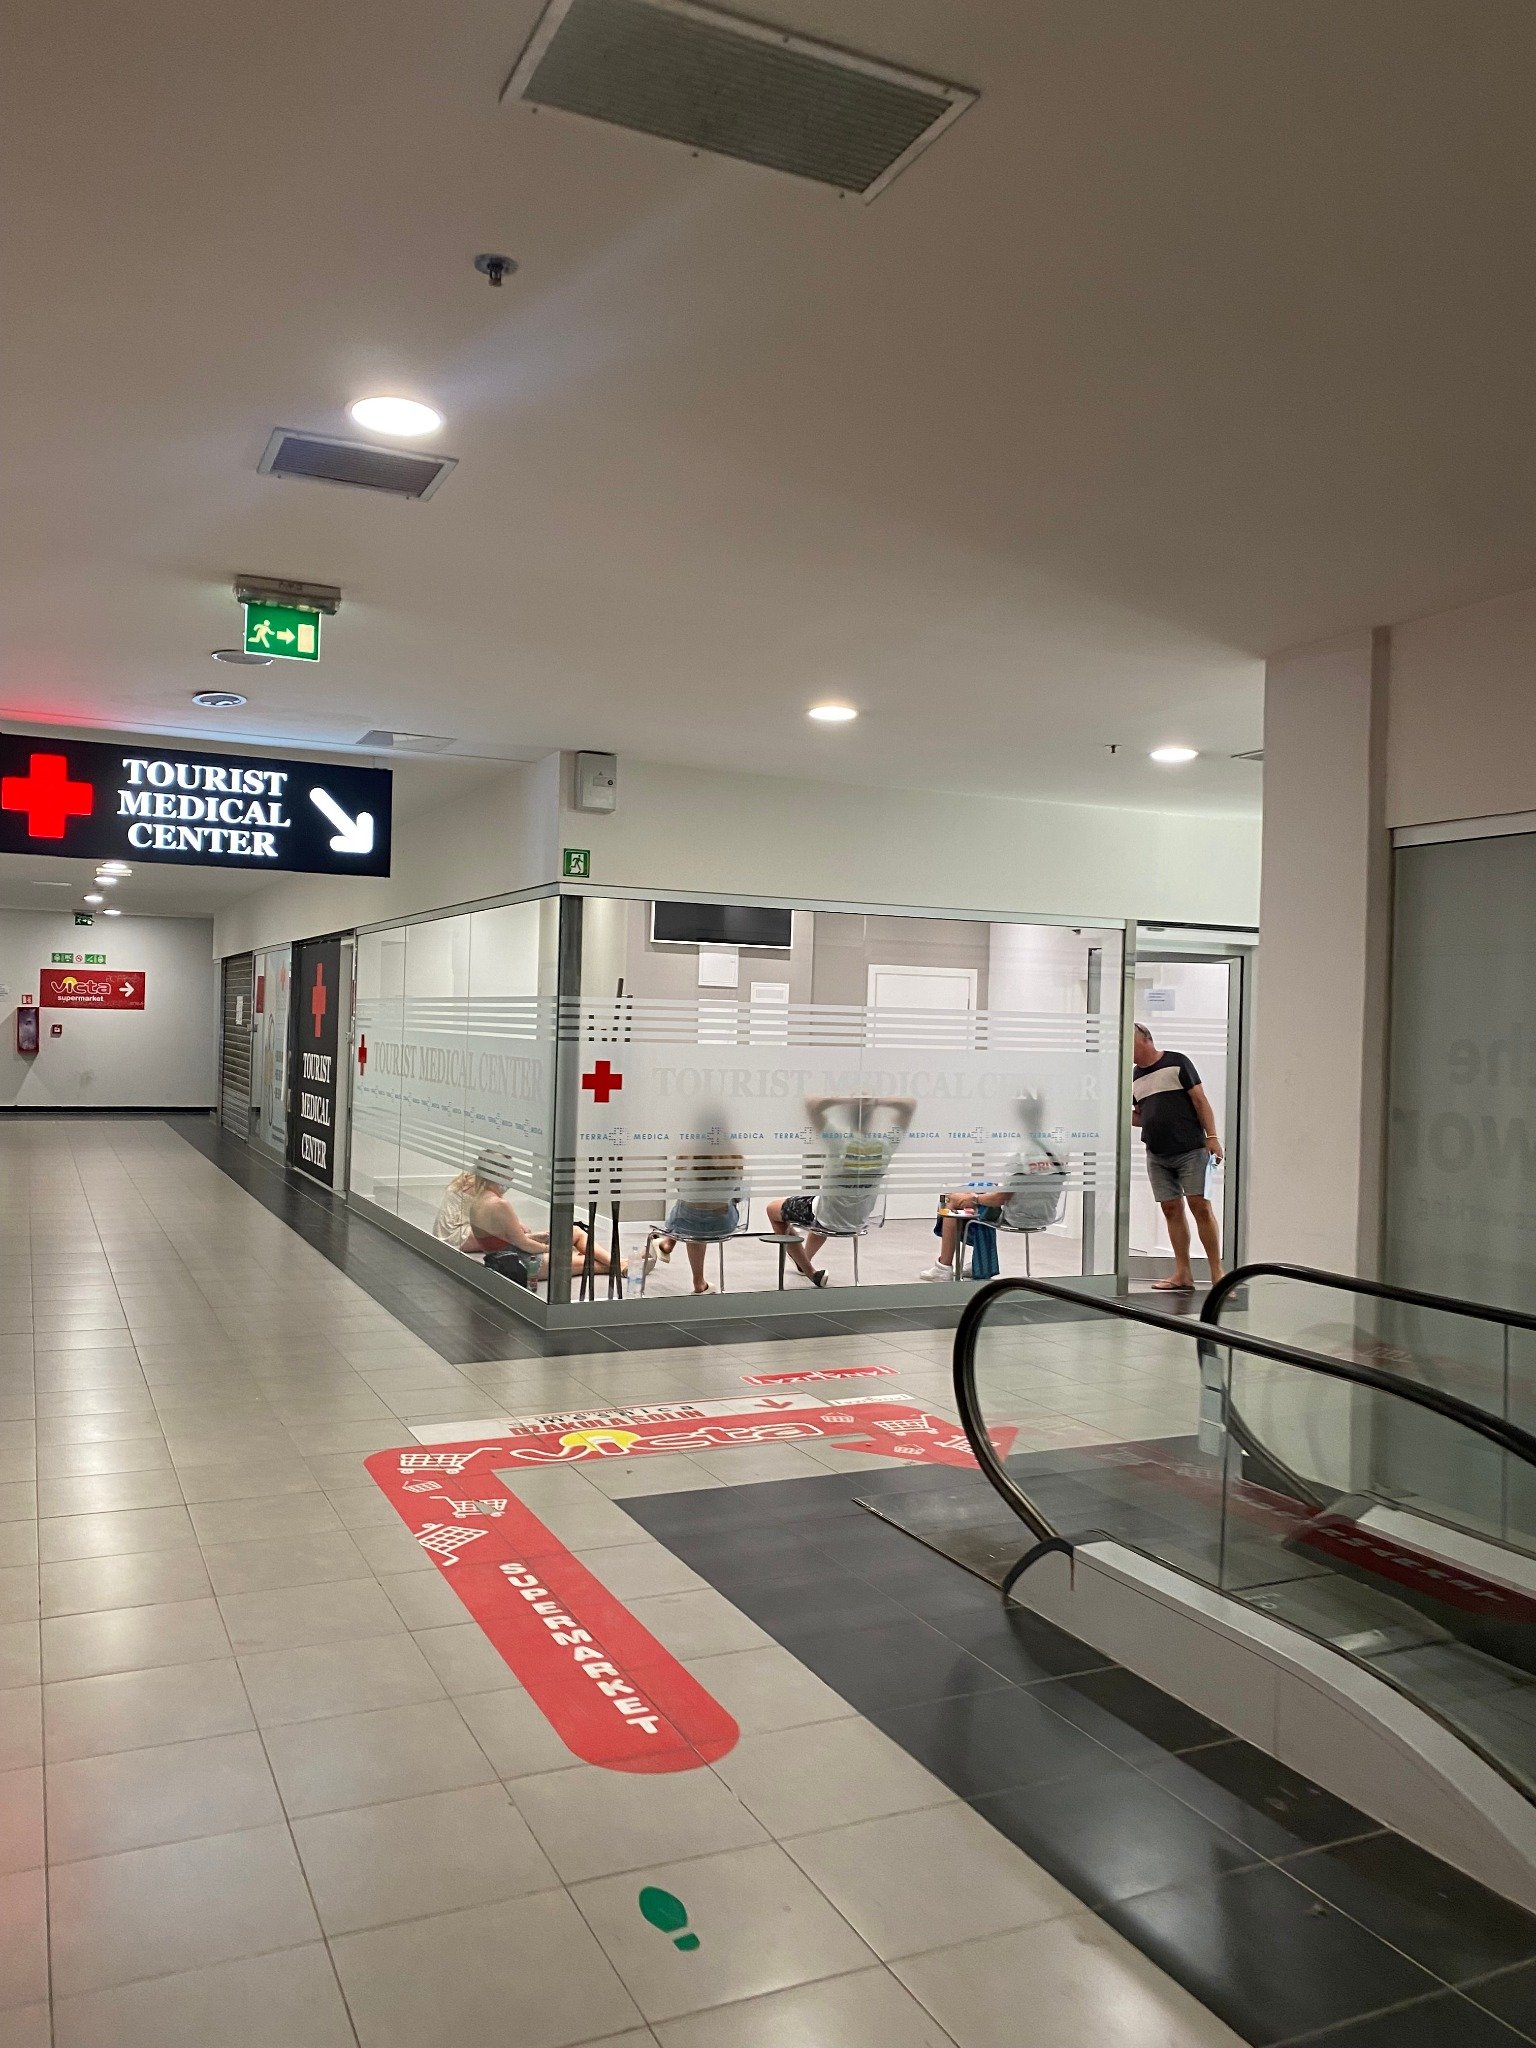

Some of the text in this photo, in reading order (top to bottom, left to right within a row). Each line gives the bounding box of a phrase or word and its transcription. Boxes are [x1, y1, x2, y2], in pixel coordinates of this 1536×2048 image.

[122, 758, 288, 797] TOURIST
[117, 790, 291, 828] MEDICAL
[127, 823, 279, 858] CENTER
[57, 995, 104, 1004] supermarket
[303, 1052, 332, 1083] TOURIST
[374, 1041, 543, 1100] TOURIST MEDICAL CENTER
[652, 1067, 813, 1098] TOURIST
[300, 1091, 331, 1126] MEDICAL
[301, 1132, 327, 1170] CENTER
[580, 1133, 609, 1141] TERRA
[629, 1410, 706, 1425] SOLIN
[498, 1561, 660, 1735] SUPERMARKET
